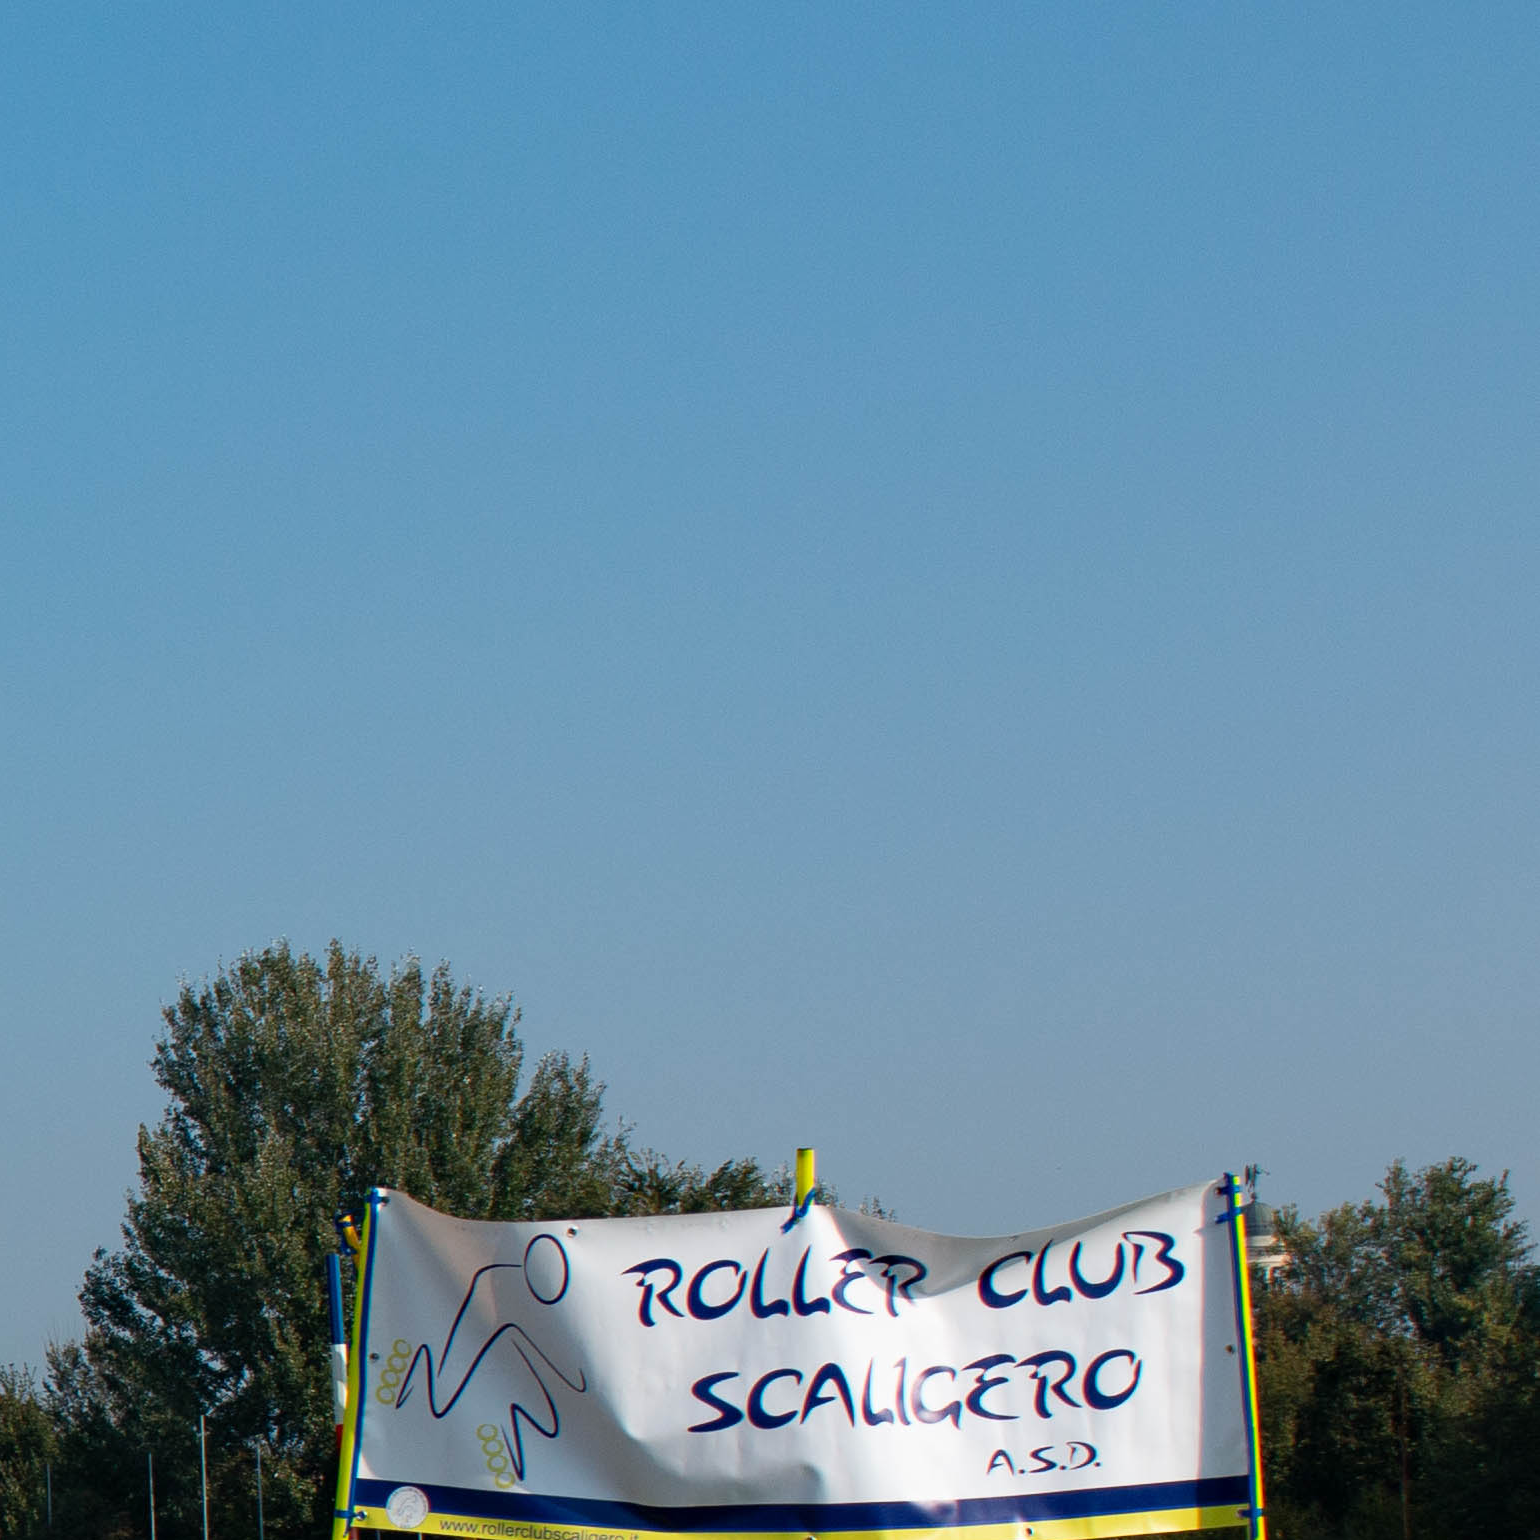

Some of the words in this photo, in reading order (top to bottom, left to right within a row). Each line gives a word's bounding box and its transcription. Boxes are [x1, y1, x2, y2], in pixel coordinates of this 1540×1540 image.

[620, 1244, 928, 1327] ROLLER
[977, 1231, 1186, 1308] CLUB
[686, 1348, 1143, 1433] SCALIGERO
[986, 1440, 1102, 1476] A.S.D.
